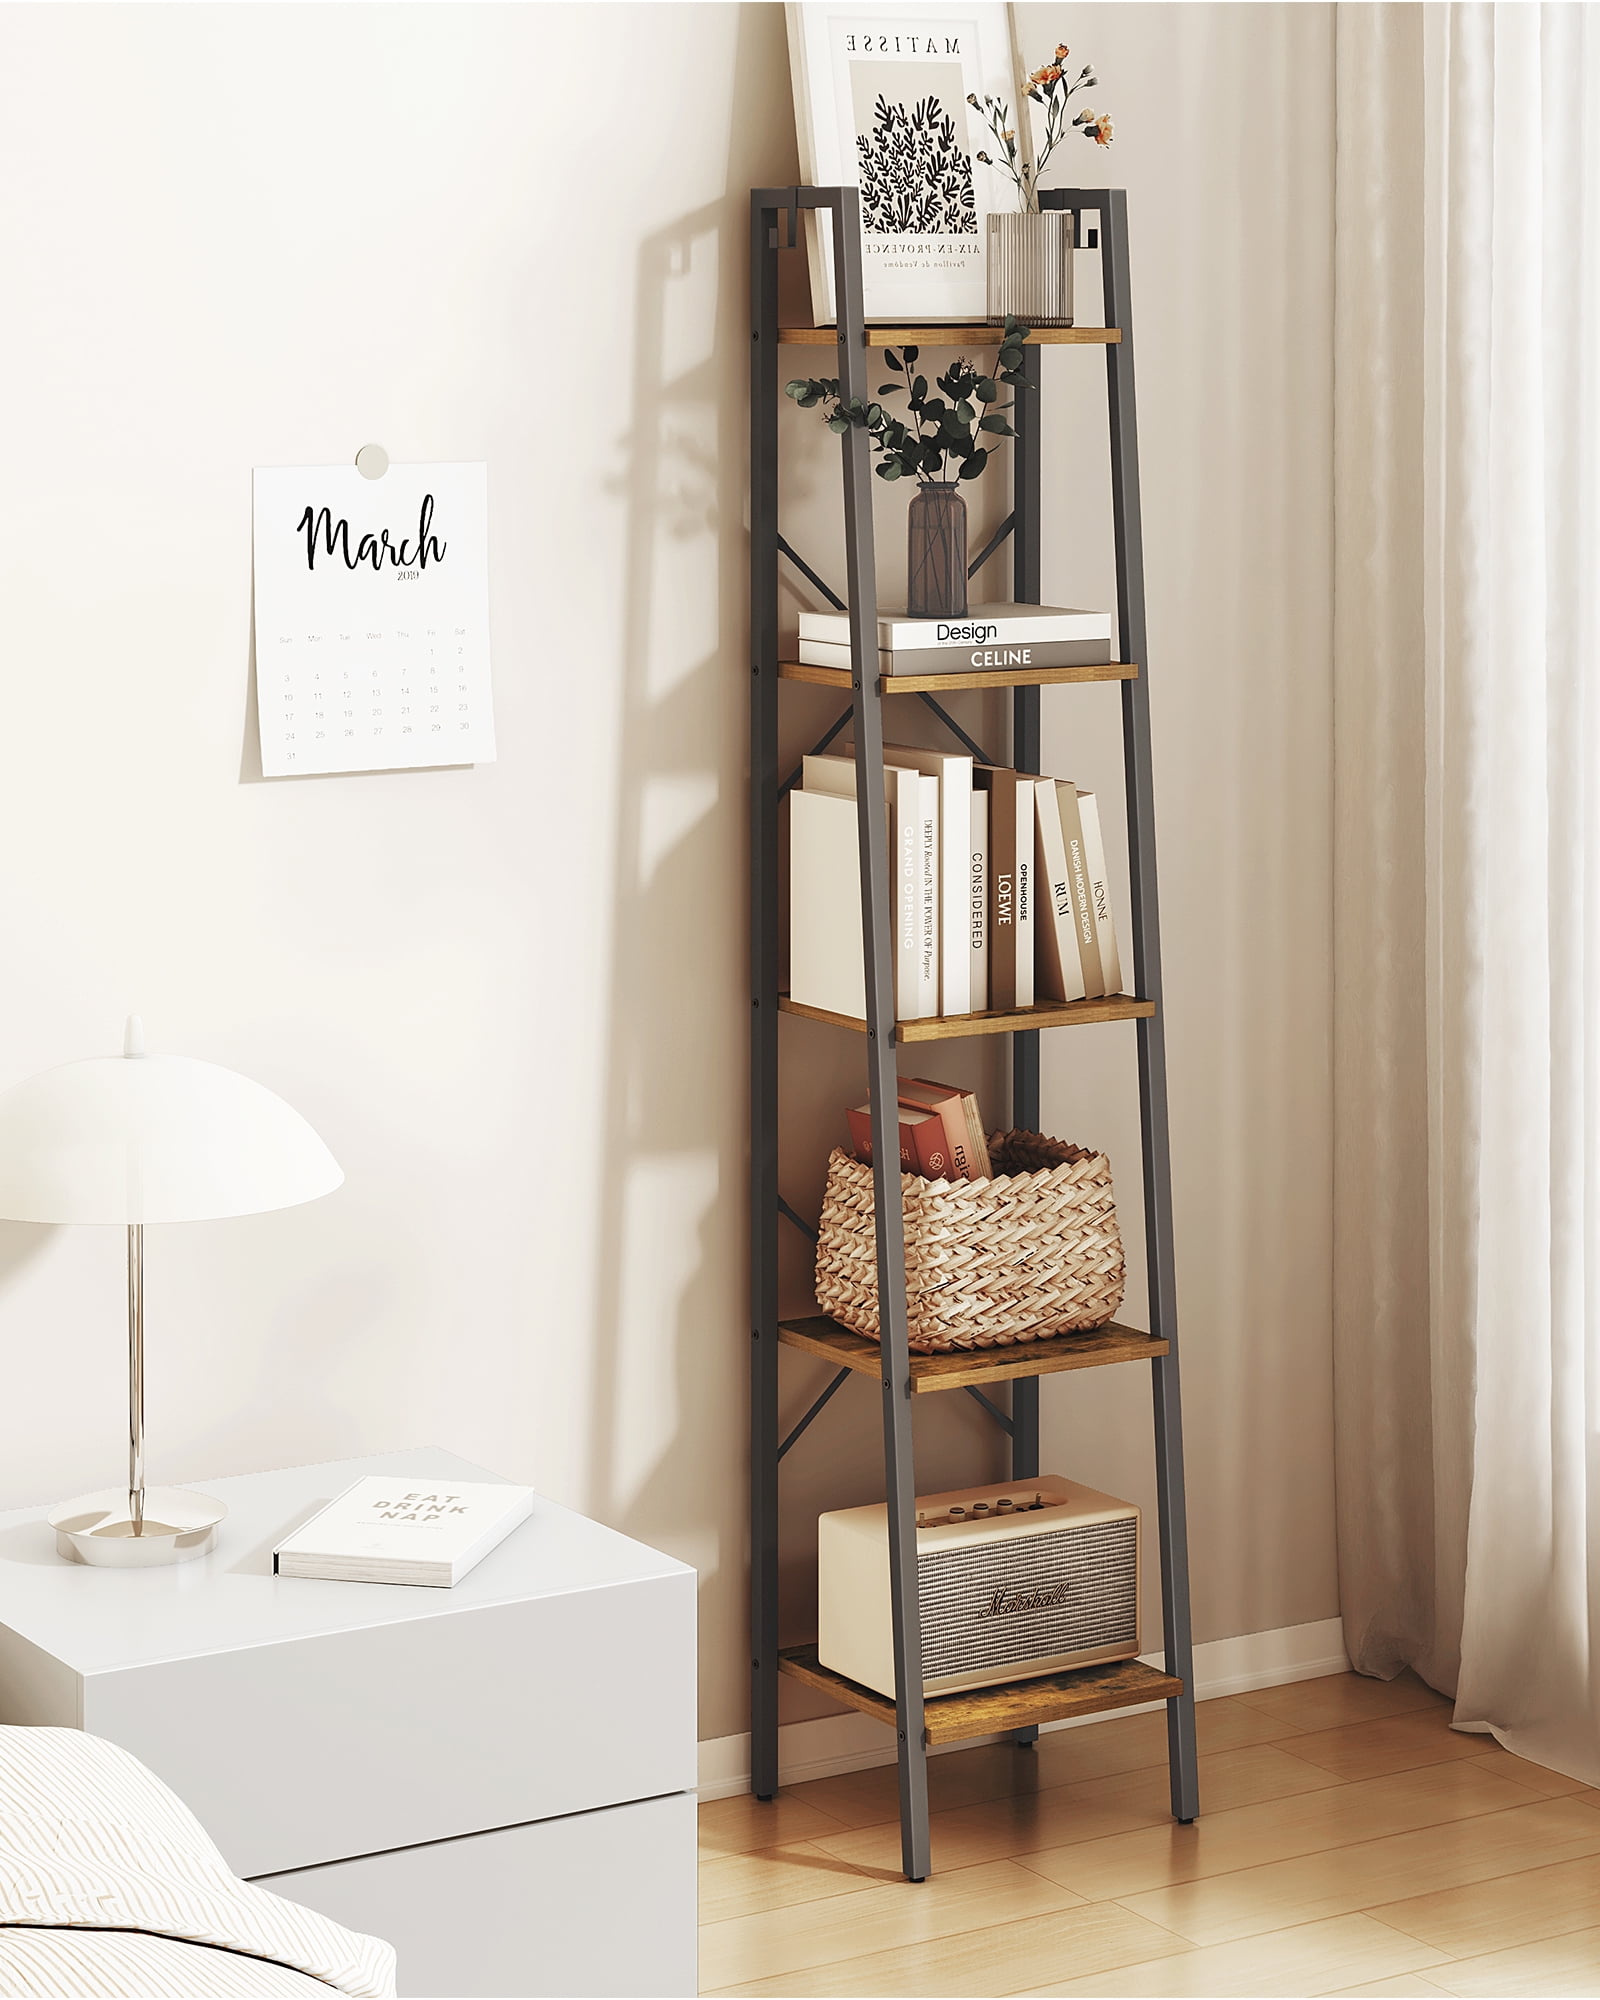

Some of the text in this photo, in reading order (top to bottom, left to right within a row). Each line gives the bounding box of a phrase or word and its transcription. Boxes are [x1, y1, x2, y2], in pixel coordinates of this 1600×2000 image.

[297, 494, 447, 570] March
[397, 570, 420, 581] 2019
[937, 622, 997, 644] Design
[430, 646, 463, 656] 1 2
[970, 649, 1032, 667] CELINE
[285, 674, 290, 682] 3
[344, 671, 349, 679] 5
[372, 670, 378, 678] 6
[402, 668, 408, 676] 7
[284, 694, 294, 702] 10
[343, 691, 352, 699] 12
[373, 689, 382, 697] 13
[401, 687, 410, 695] 14
[430, 686, 439, 694] 15
[286, 713, 294, 721] 17
[344, 710, 353, 718] 19
[372, 708, 383, 716] 20
[402, 706, 410, 714] 21
[430, 704, 440, 712] 22
[459, 703, 469, 711] 23
[287, 732, 295, 740] 24
[316, 730, 326, 738] 25
[344, 729, 354, 737] 26
[374, 727, 384, 735] 27
[432, 724, 441, 732] 29
[460, 722, 470, 730] 30
[288, 752, 296, 760] 31
[924, 819, 933, 850] DEEPLY
[924, 851, 933, 876] Rooted
[904, 825, 913, 949] GRAND OPENING
[924, 877, 933, 886] IN
[924, 888, 933, 904] THE
[972, 852, 983, 949] CONSIDERED
[998, 873, 1012, 926] LOEWE
[1020, 863, 1028, 921] OPENHOUSE
[1054, 881, 1069, 916] RUM
[1070, 839, 1093, 944] DANISH MODERN DESIGN
[1093, 880, 1108, 921] HONNE
[924, 906, 933, 936] POWER
[924, 937, 933, 949] OF
[372, 1501, 469, 1513] DRINK
[403, 1493, 461, 1503] EAT
[379, 1511, 440, 1521] NAP
[979, 1582, 1069, 1617] Marshall
